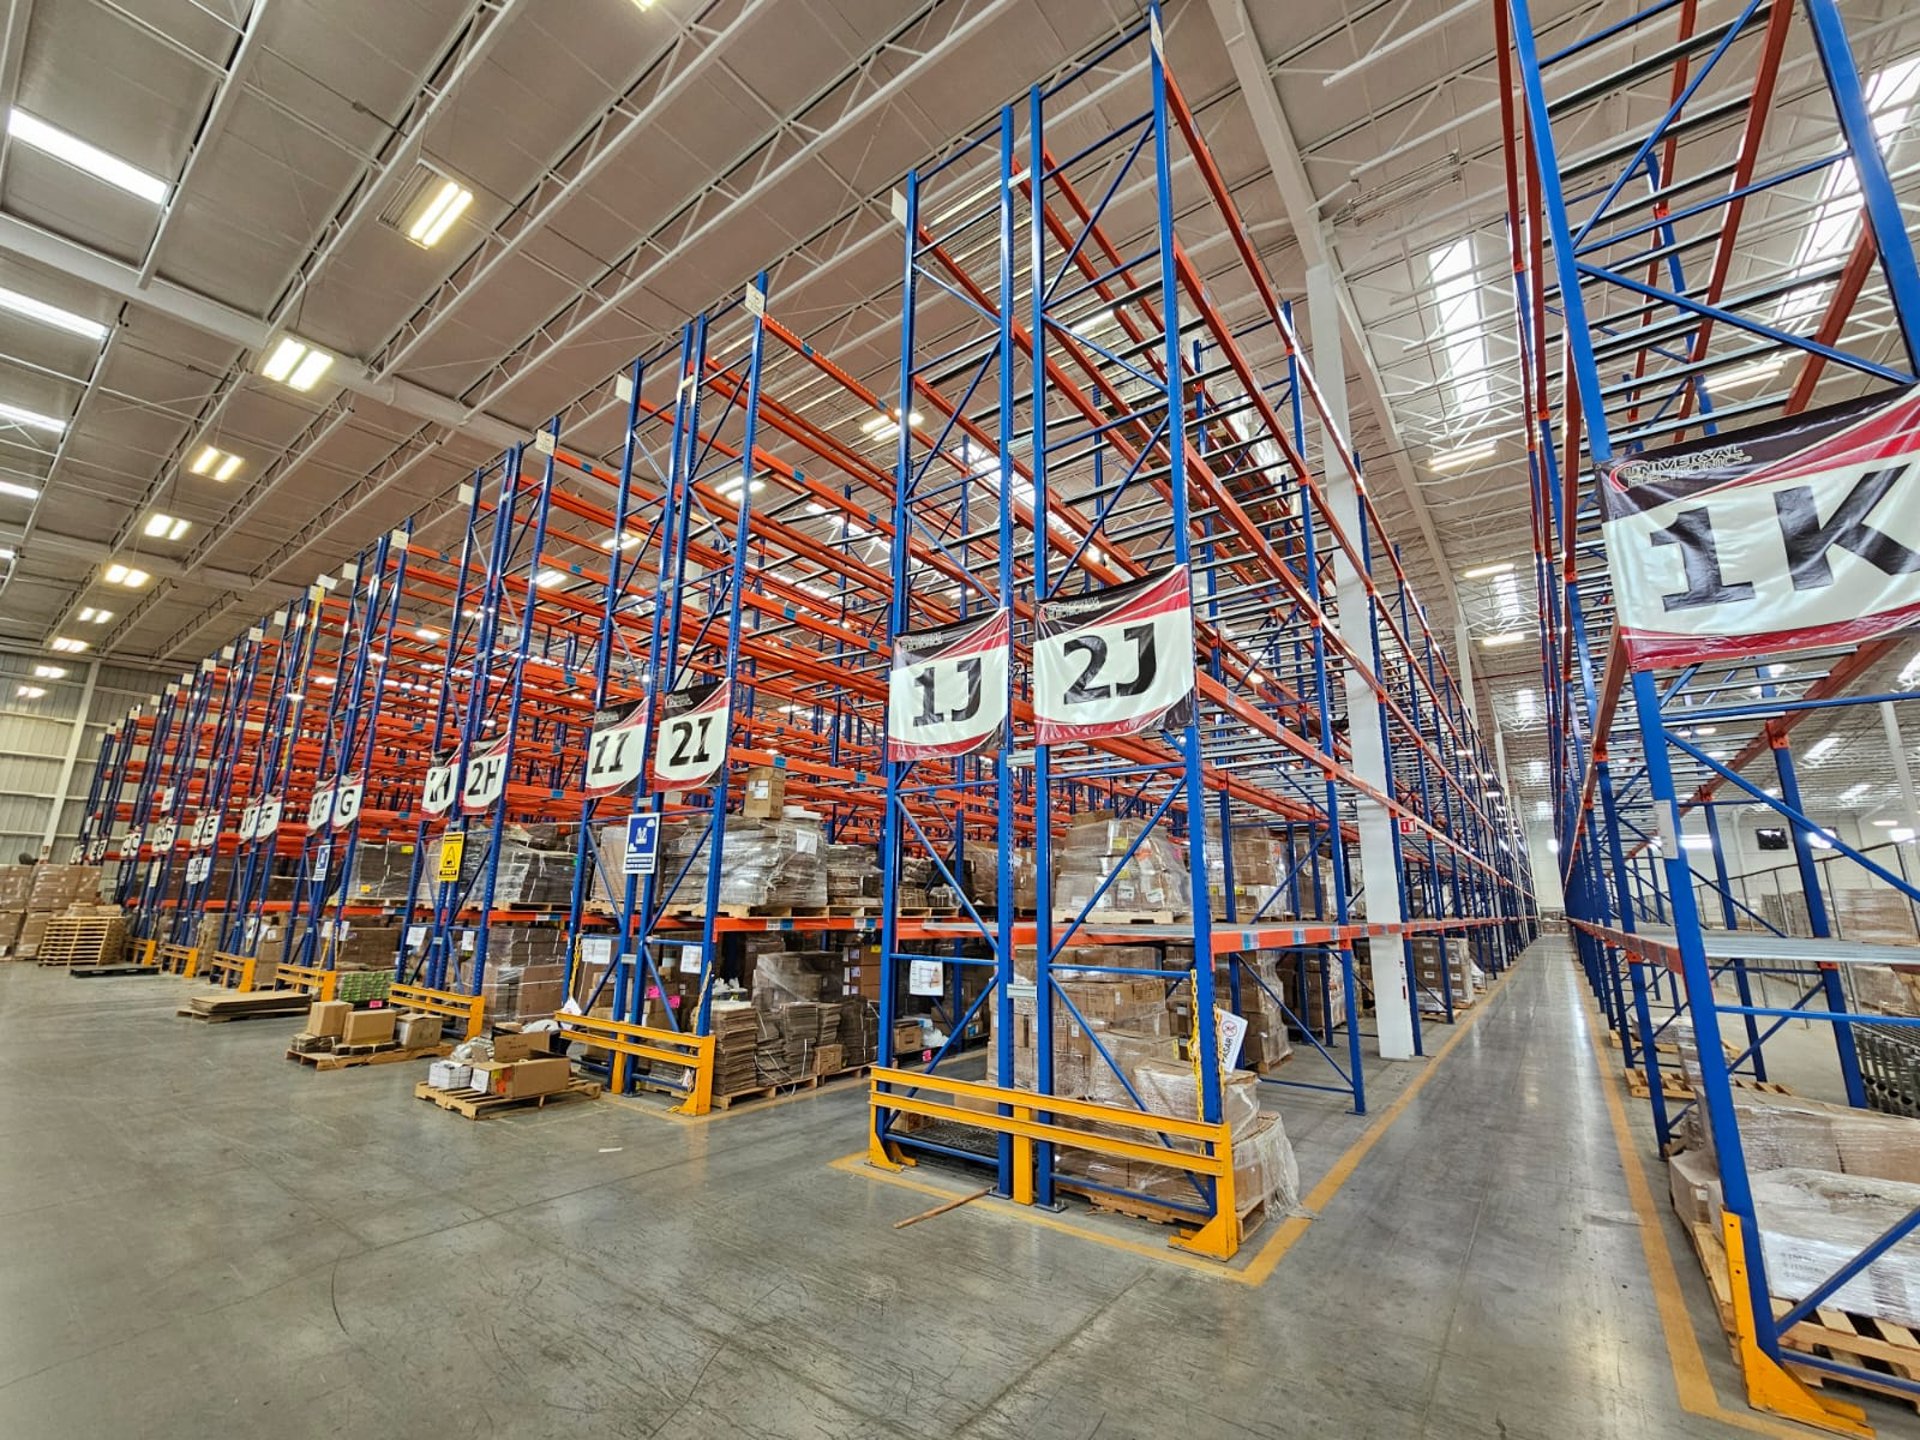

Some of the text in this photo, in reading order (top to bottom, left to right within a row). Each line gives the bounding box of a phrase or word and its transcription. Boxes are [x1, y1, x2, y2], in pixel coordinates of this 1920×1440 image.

[1625, 444, 1745, 476] UNIVERSAL
[1649, 462, 1920, 613] 1K
[912, 656, 982, 727] 1J
[1063, 621, 1158, 705] 2J
[467, 757, 502, 796] 2H
